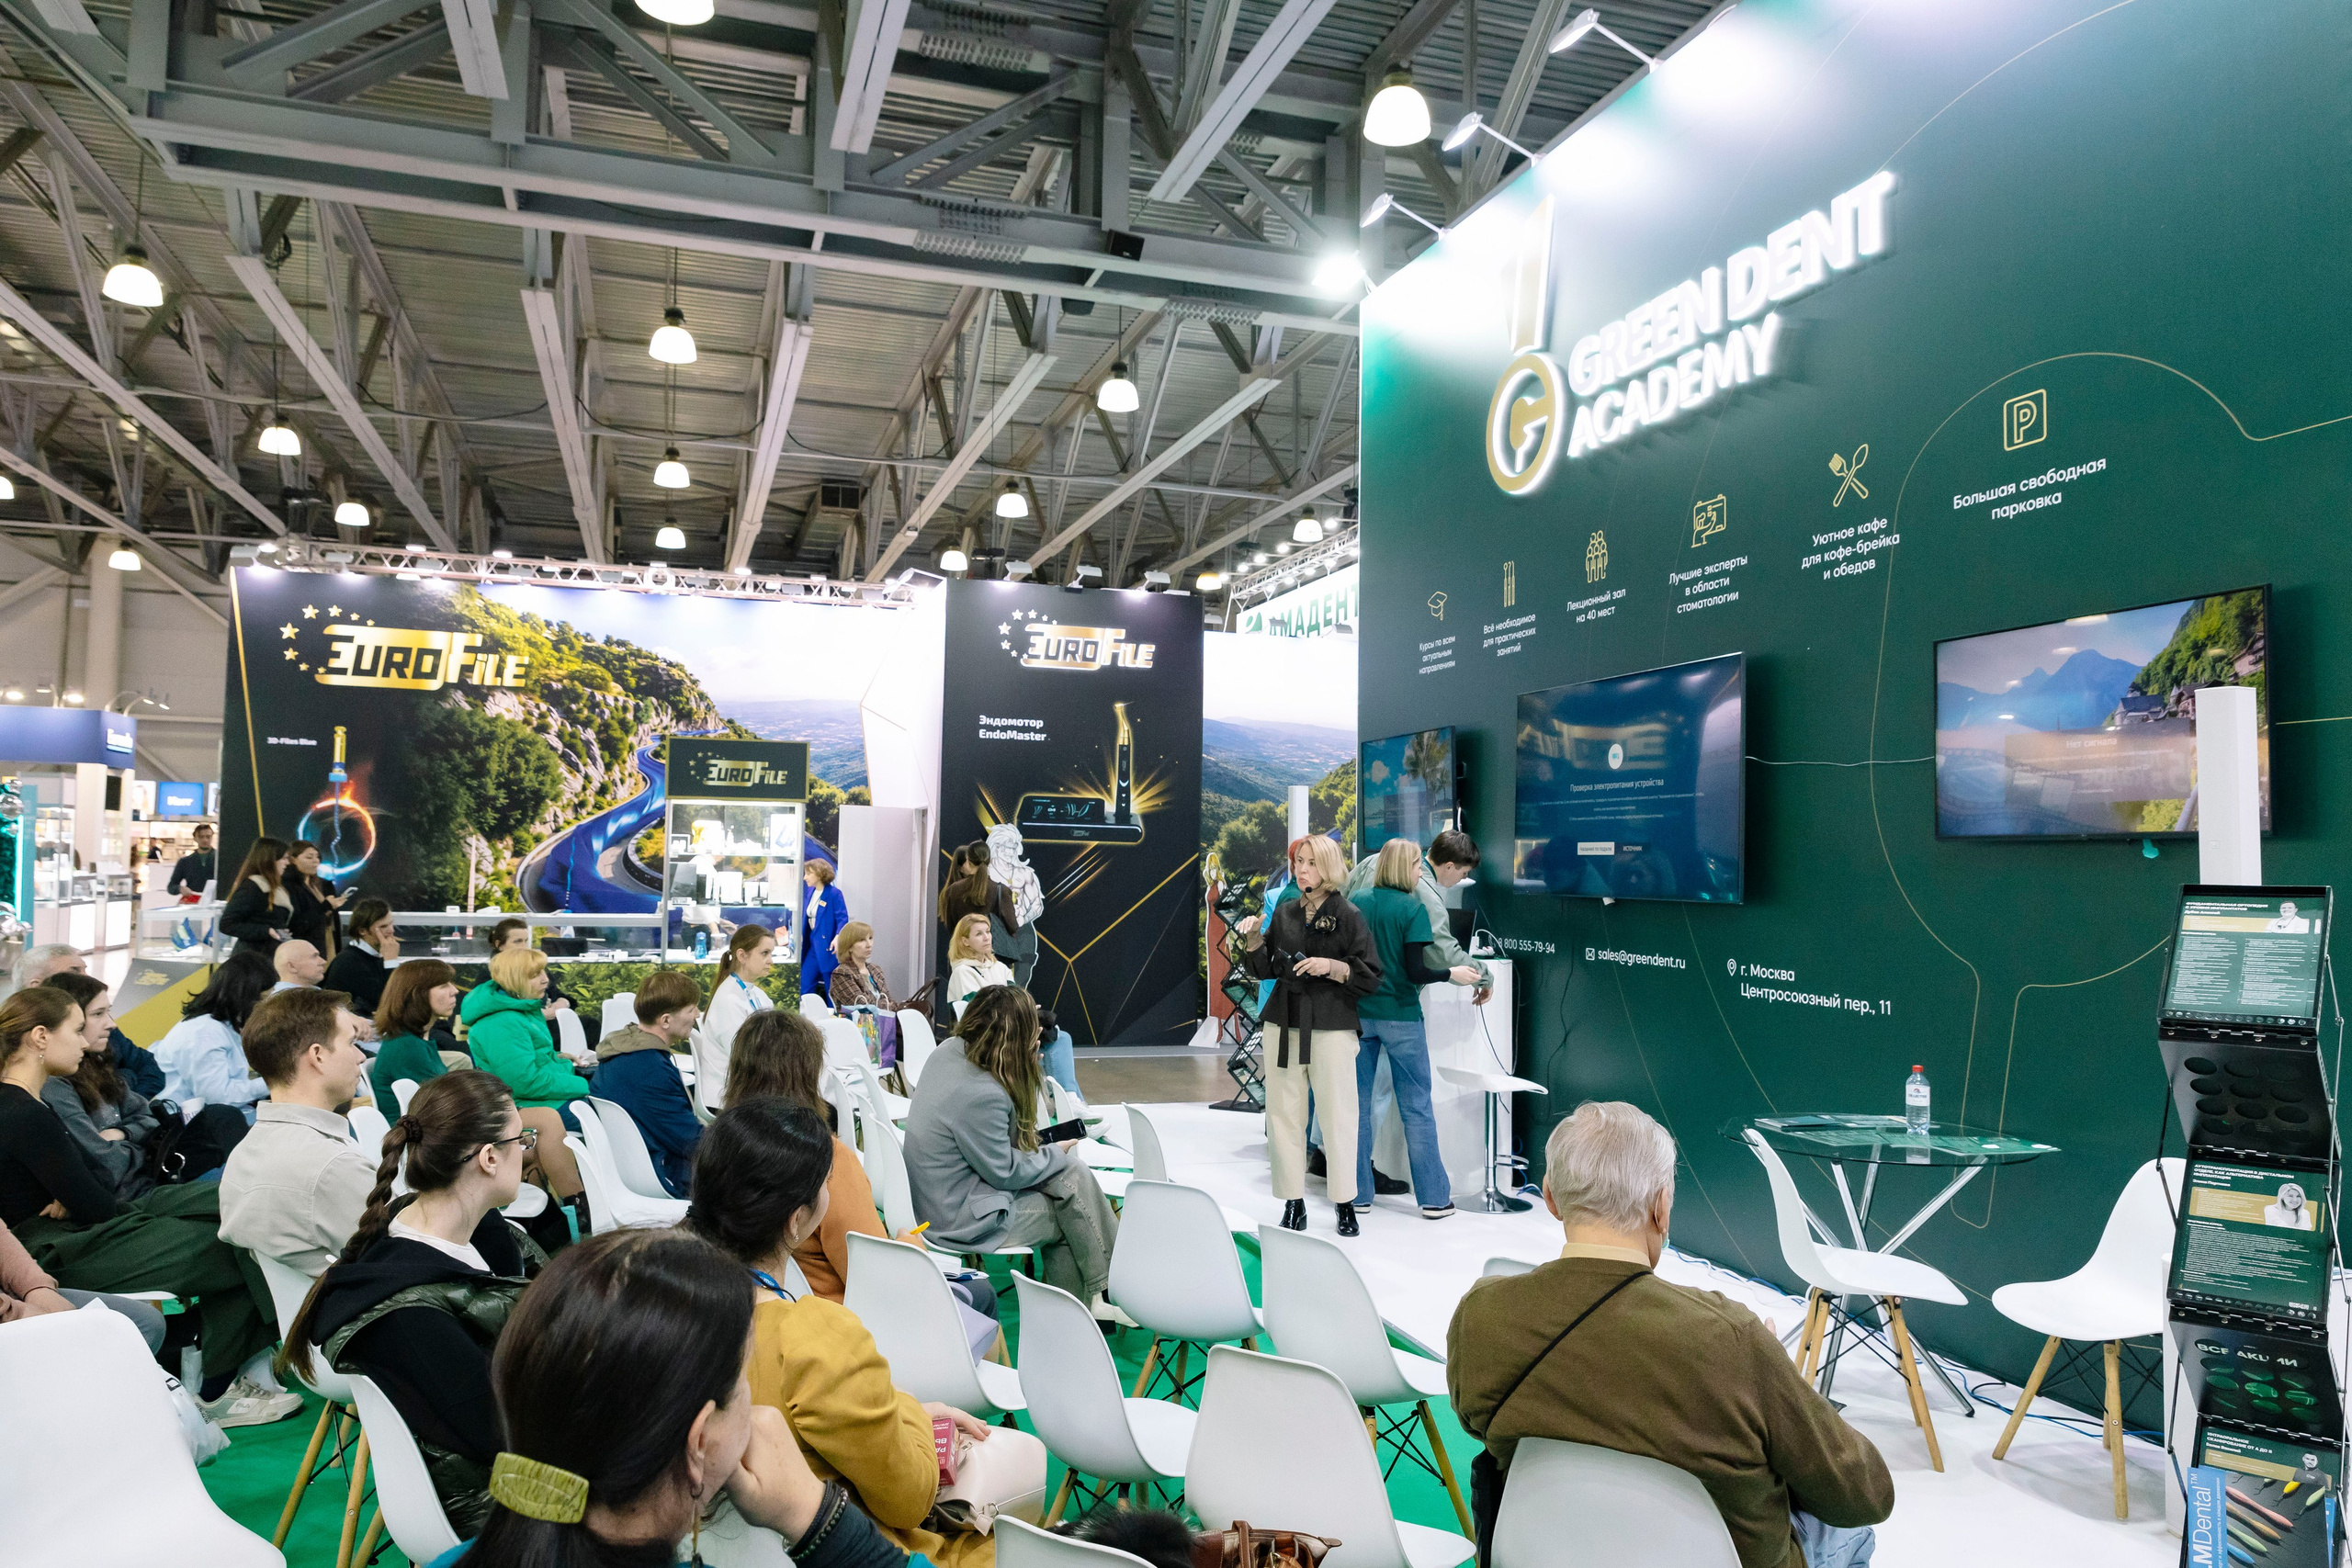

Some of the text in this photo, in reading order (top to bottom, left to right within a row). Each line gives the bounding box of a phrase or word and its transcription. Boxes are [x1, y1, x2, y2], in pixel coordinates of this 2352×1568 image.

[1567, 171, 1898, 397] GREEN DENT
[1566, 312, 1781, 458] ACADEMY
[1953, 457, 2107, 510] Большая свободная
[1991, 491, 2063, 520] парковка
[1812, 516, 1888, 547] Уютное кафе
[1801, 532, 1900, 570] для кофе-брейка
[1668, 554, 1748, 586] Лучшие эксперты
[1823, 557, 1876, 580] и обедов
[1685, 575, 1730, 596] в области
[1566, 587, 1626, 612] Лекционный зал
[1677, 591, 1739, 614] стоматологии
[1483, 613, 1536, 635] Всё необходимое
[1576, 605, 1615, 624] на 40 мест
[1419, 635, 1456, 652] Курсы по всем
[1483, 627, 1536, 649] для практических
[1422, 648, 1453, 662] актуальным
[1497, 643, 1521, 657] занятий
[1419, 659, 1456, 675] направлениям
[978, 716, 1044, 729] Эндомотор
[978, 728, 1047, 742] EndoMaster
[2066, 737, 2118, 749] Нет сигнала
[1570, 777, 1665, 793] Проверка электропитания устройства
[1504, 938, 1518, 950] 800
[1519, 939, 1555, 954] 555-79-94
[1598, 948, 1686, 969] sales@greendent.ru
[1740, 964, 1795, 982] г. Москва
[1740, 983, 1892, 1016] Центросоюзный пер., 11
